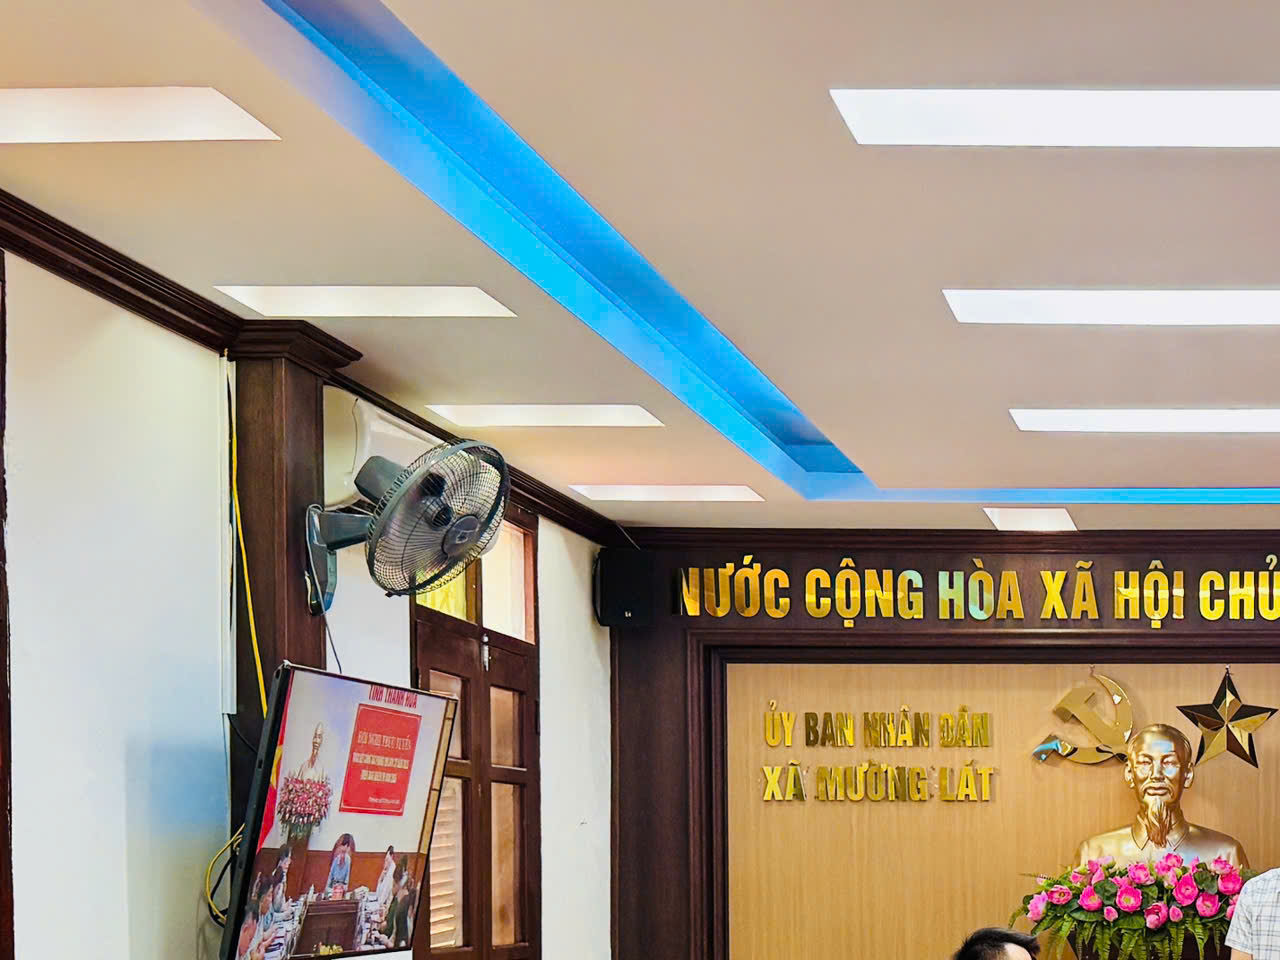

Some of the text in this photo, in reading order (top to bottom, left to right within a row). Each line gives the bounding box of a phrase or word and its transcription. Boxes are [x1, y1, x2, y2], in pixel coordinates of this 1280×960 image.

[672, 554, 790, 619] NƯỚC
[805, 557, 924, 628] CỘNG
[938, 558, 1025, 620] HÒA
[1039, 560, 1100, 620] XÃ
[1114, 560, 1184, 629] HỘI
[764, 700, 993, 748] ỦY BAN NHÂN DÂN
[762, 759, 994, 802] XÃ MƯỜNG LÁT
